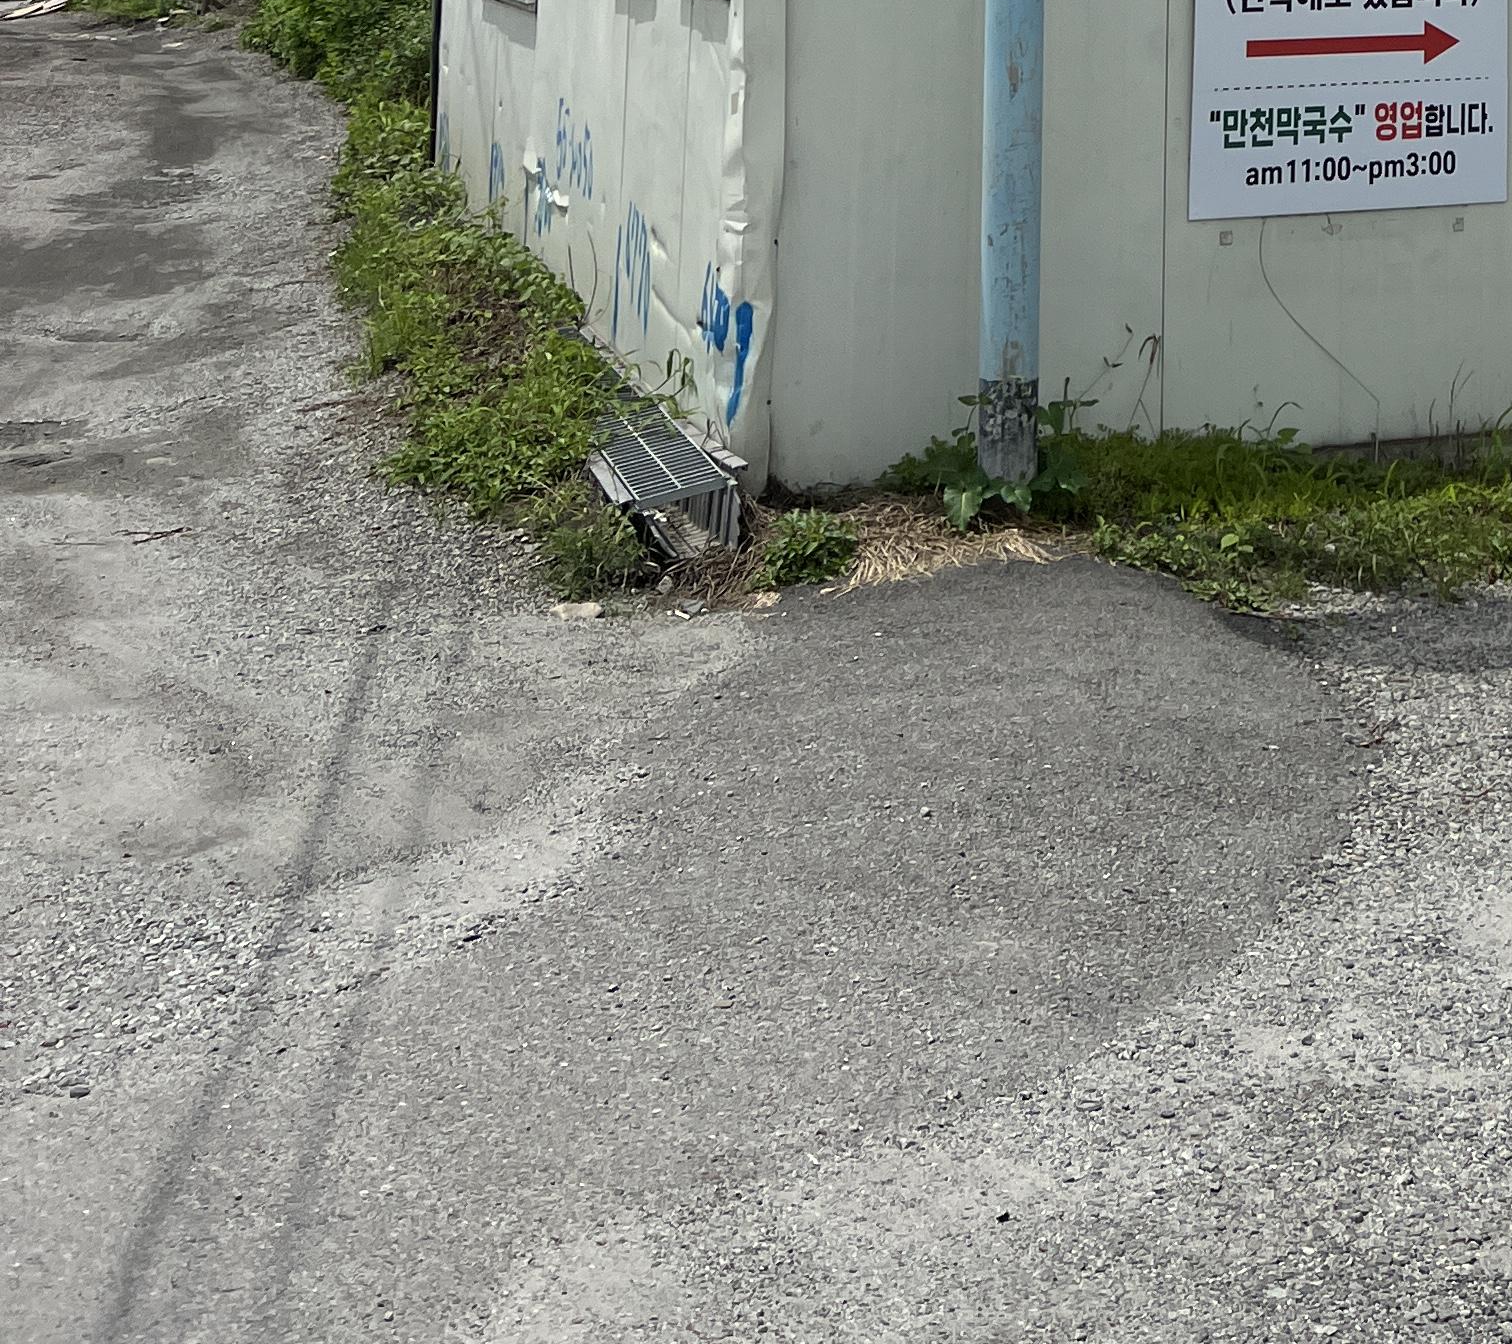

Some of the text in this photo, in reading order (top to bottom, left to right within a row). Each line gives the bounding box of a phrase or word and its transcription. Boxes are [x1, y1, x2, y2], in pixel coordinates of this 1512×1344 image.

[1209, 100, 1494, 149] "만천막국수" 영업합니다.
[1245, 150, 1457, 187] am11:00~pm3:00
